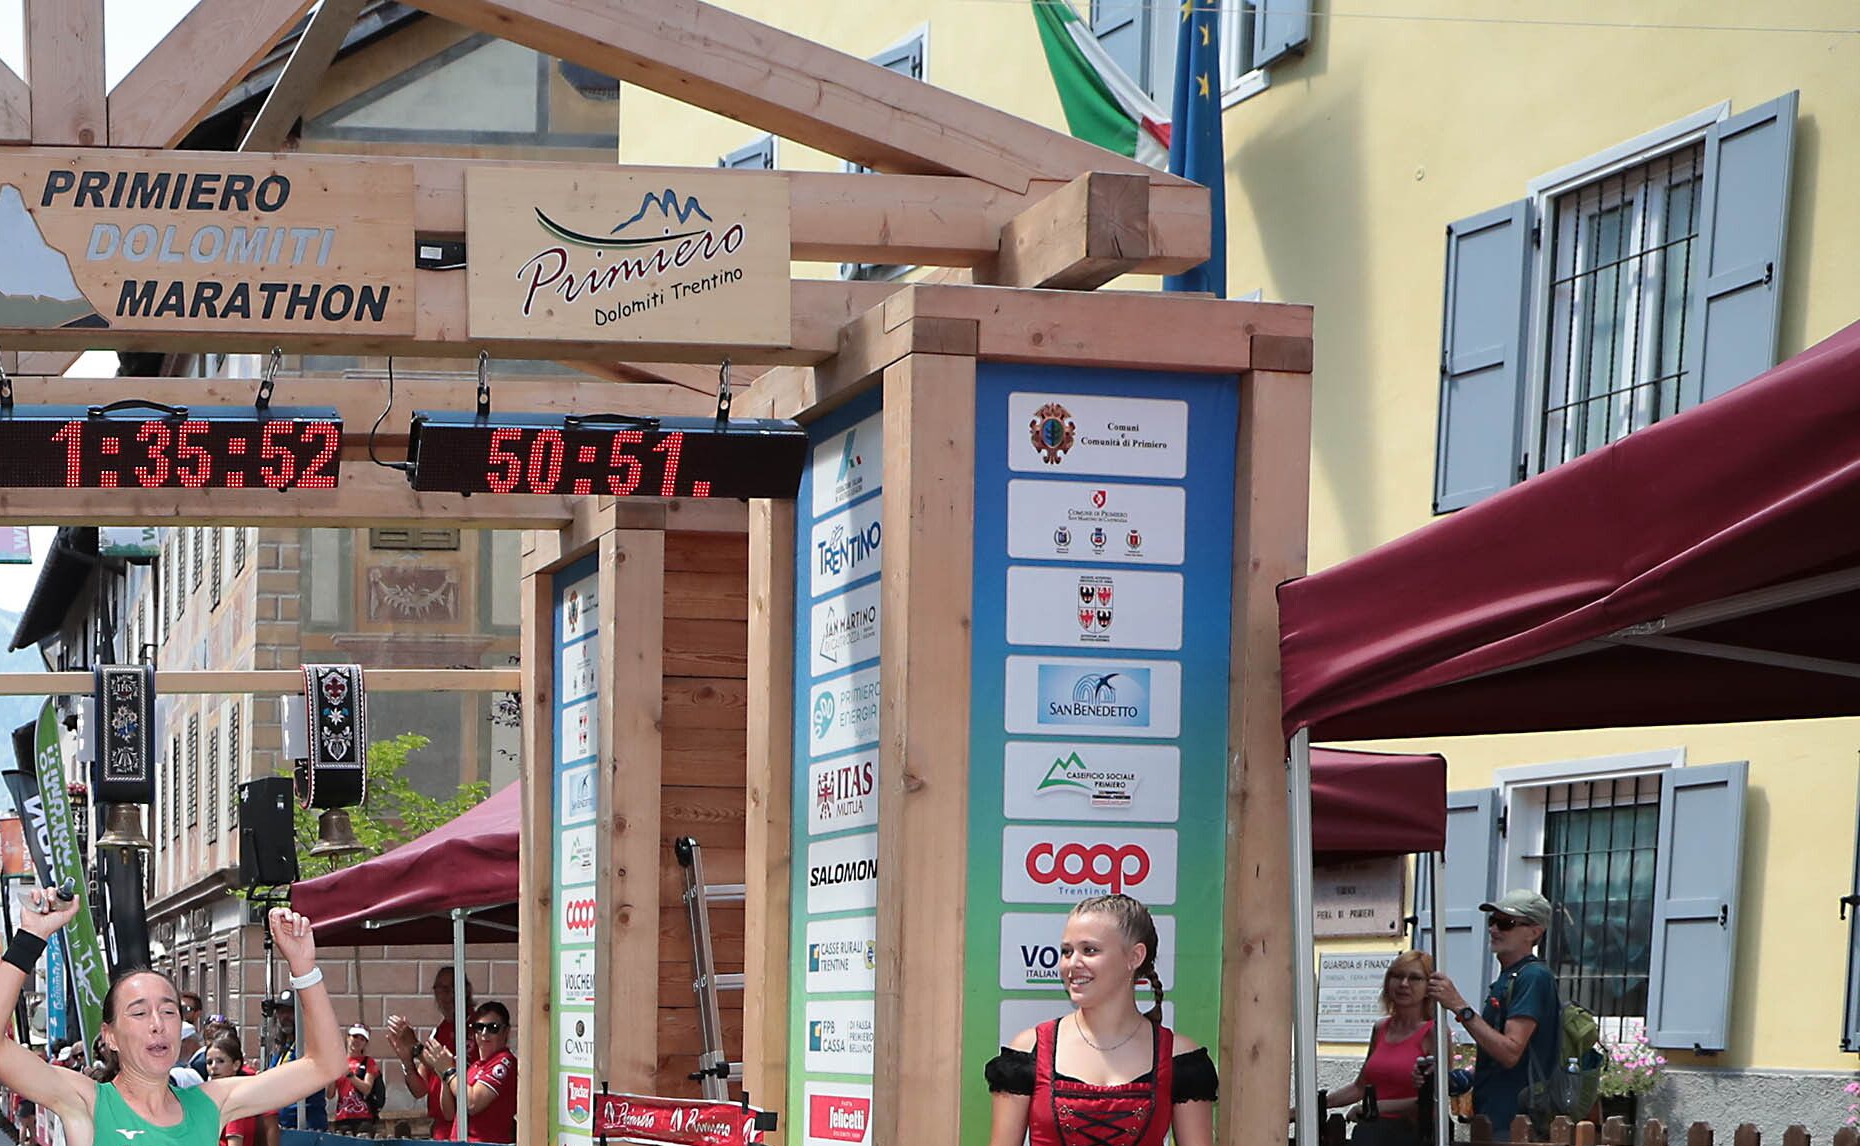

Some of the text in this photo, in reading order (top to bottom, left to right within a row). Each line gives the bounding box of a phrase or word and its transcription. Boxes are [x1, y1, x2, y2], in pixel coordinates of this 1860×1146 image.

[41, 169, 291, 213] PRIMIERO
[85, 223, 336, 266] DOLOMITI
[516, 220, 746, 318] Primiero
[115, 279, 390, 323] MARATHON
[594, 265, 744, 328] Dolomiti Trentino
[1107, 422, 1139, 432] Comuni
[49, 420, 338, 489] 1:35:52
[1080, 437, 1168, 450] Comunità di Primiero
[818, 521, 881, 576] TRENTINO
[840, 703, 876, 728] ENERGIA
[836, 761, 873, 801] ITAS
[1066, 772, 1104, 780] CASEIFICIO
[836, 798, 864, 817] MUTUA
[810, 857, 878, 888] SALOMON
[1025, 843, 1150, 894] coop
[1058, 886, 1107, 895] Trentino
[821, 942, 840, 956] CASSE
[820, 958, 849, 972] TRENTINE
[1323, 960, 1354, 970] GUARDIA
[823, 1020, 835, 1034] FPB
[823, 1039, 846, 1053] CASSA
